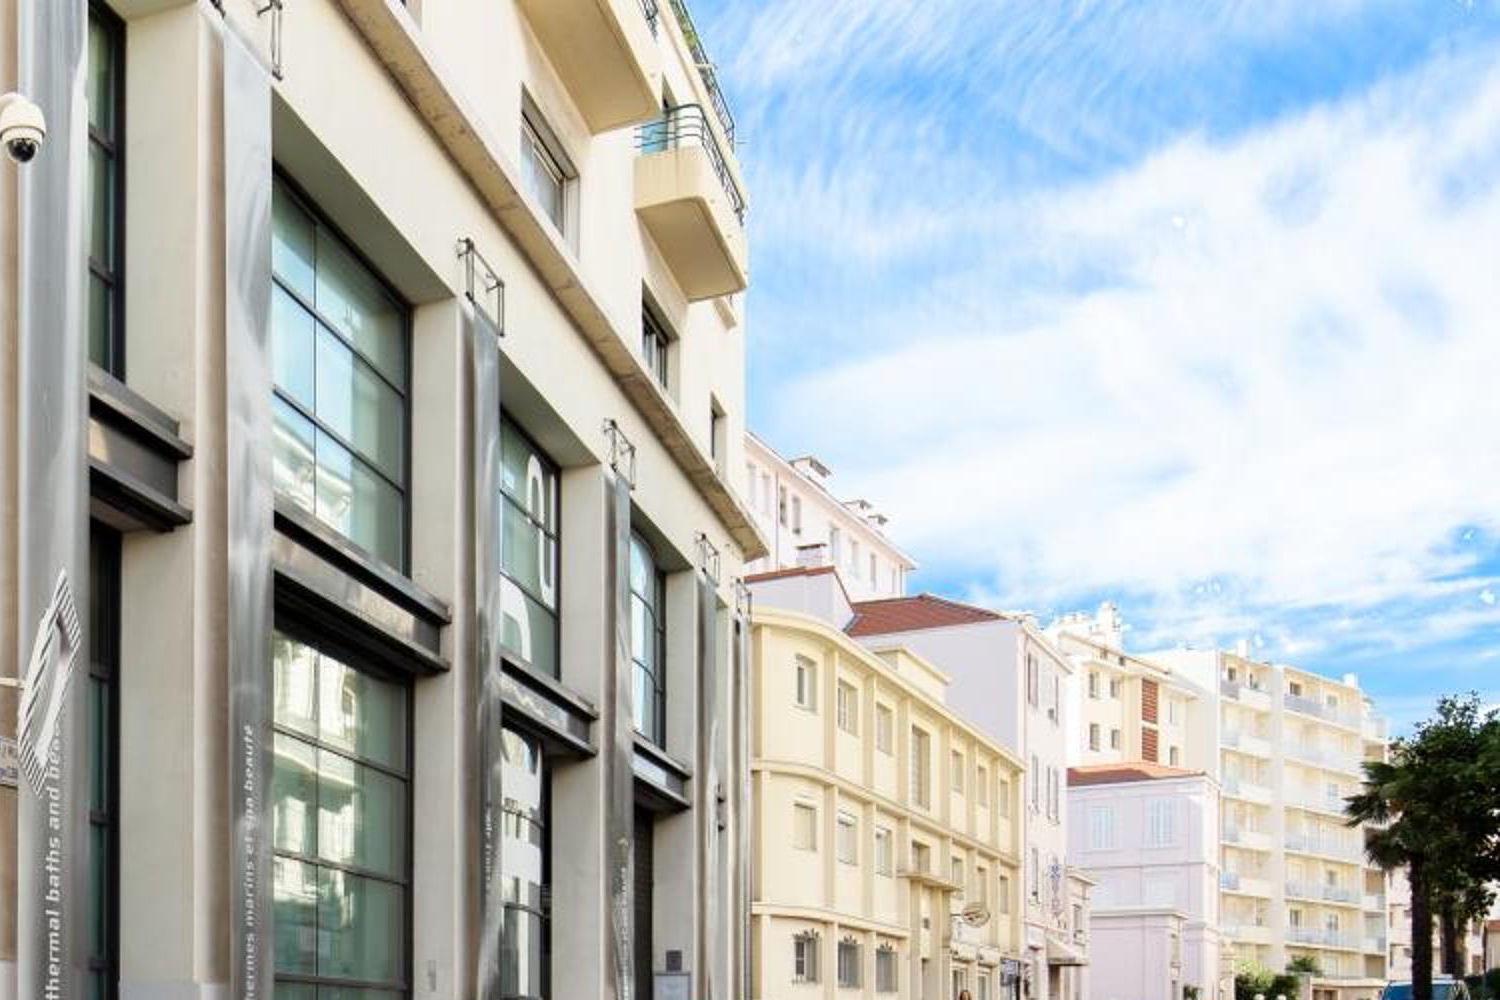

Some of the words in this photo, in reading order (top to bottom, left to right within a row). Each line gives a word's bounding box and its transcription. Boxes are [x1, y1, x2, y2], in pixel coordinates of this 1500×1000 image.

[47, 719, 60, 781] bea
[45, 785, 60, 830] and
[45, 836, 60, 902] baths
